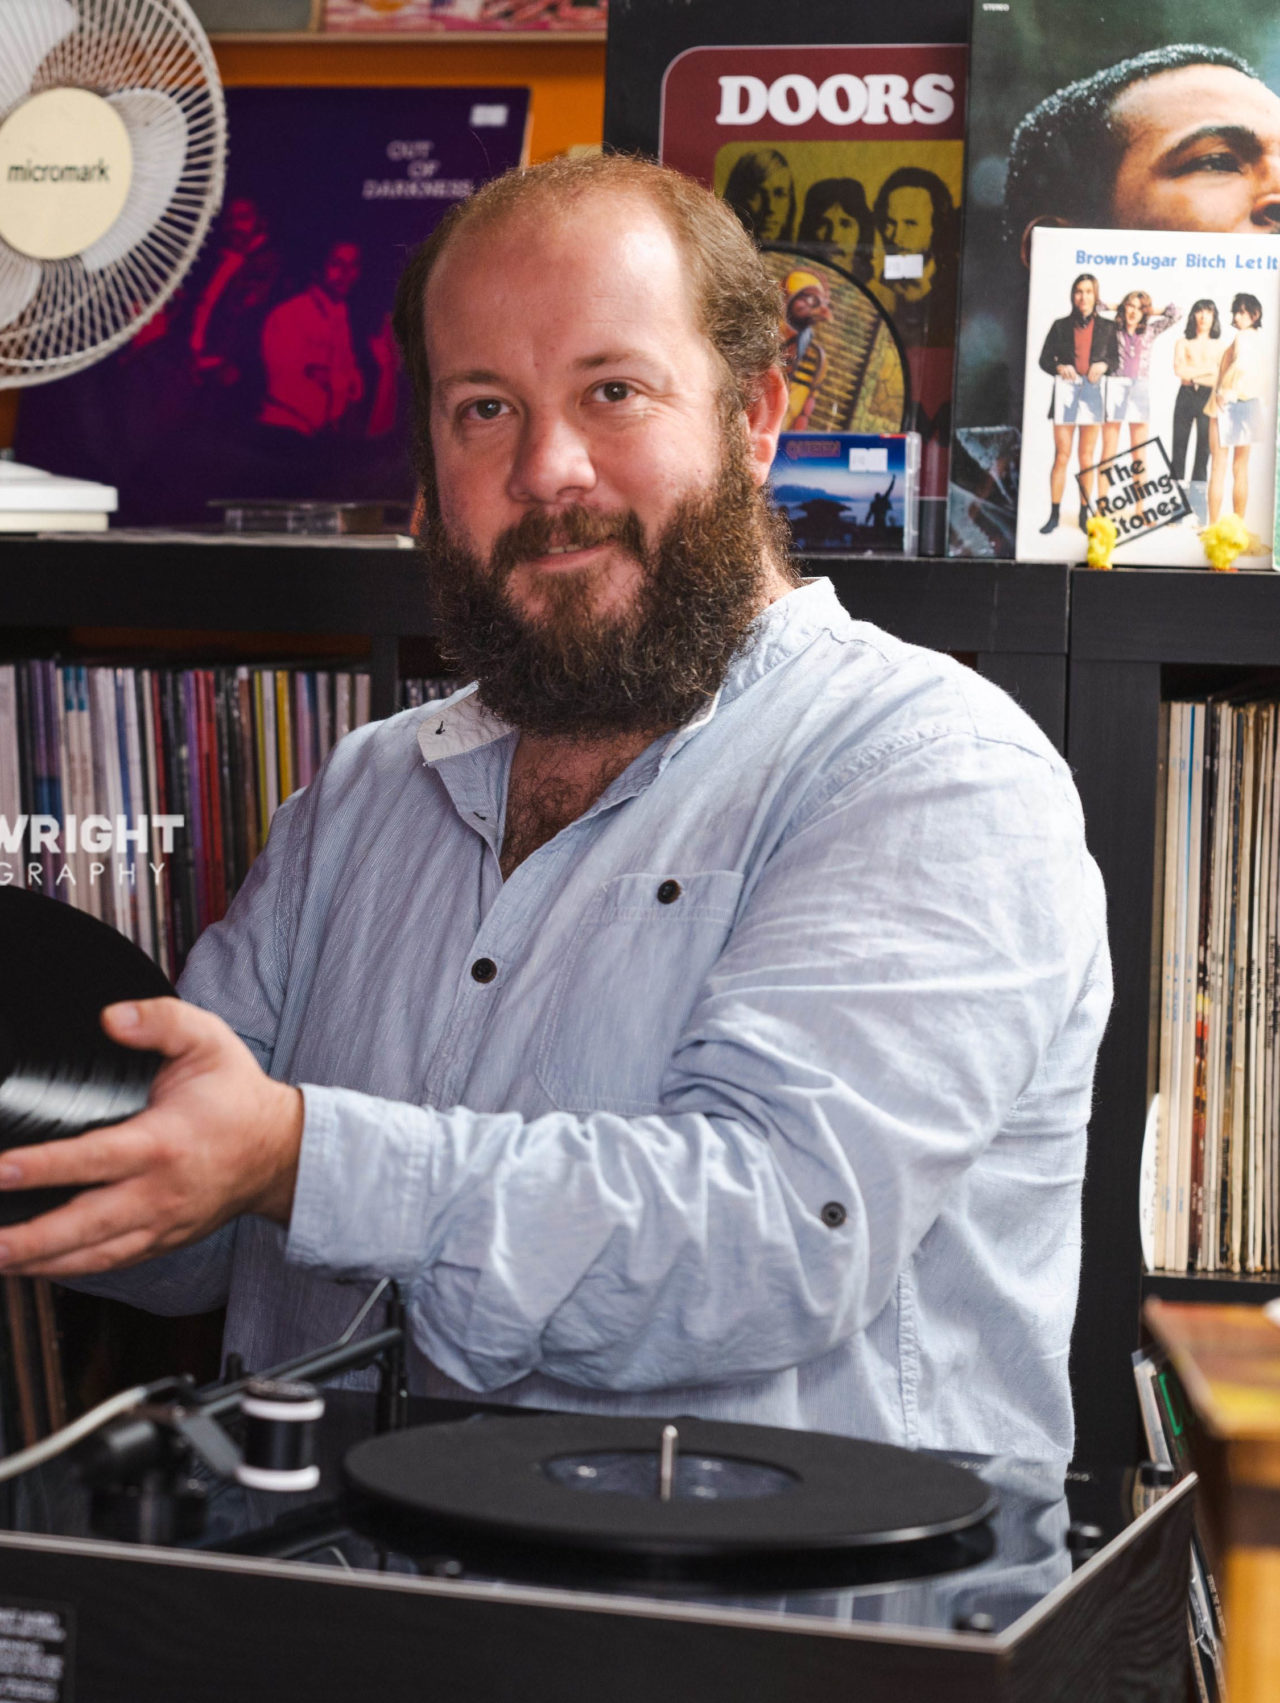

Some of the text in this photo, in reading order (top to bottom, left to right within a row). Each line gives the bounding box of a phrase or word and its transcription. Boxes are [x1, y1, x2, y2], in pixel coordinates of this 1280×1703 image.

[716, 73, 955, 126] DOORS
[387, 140, 434, 161] OUT
[7, 158, 111, 182] micromark
[407, 159, 441, 179] OF
[1075, 250, 1278, 270] Brown Sugar Bitch Let It
[1099, 460, 1145, 487] The
[1096, 474, 1174, 517] Rolling
